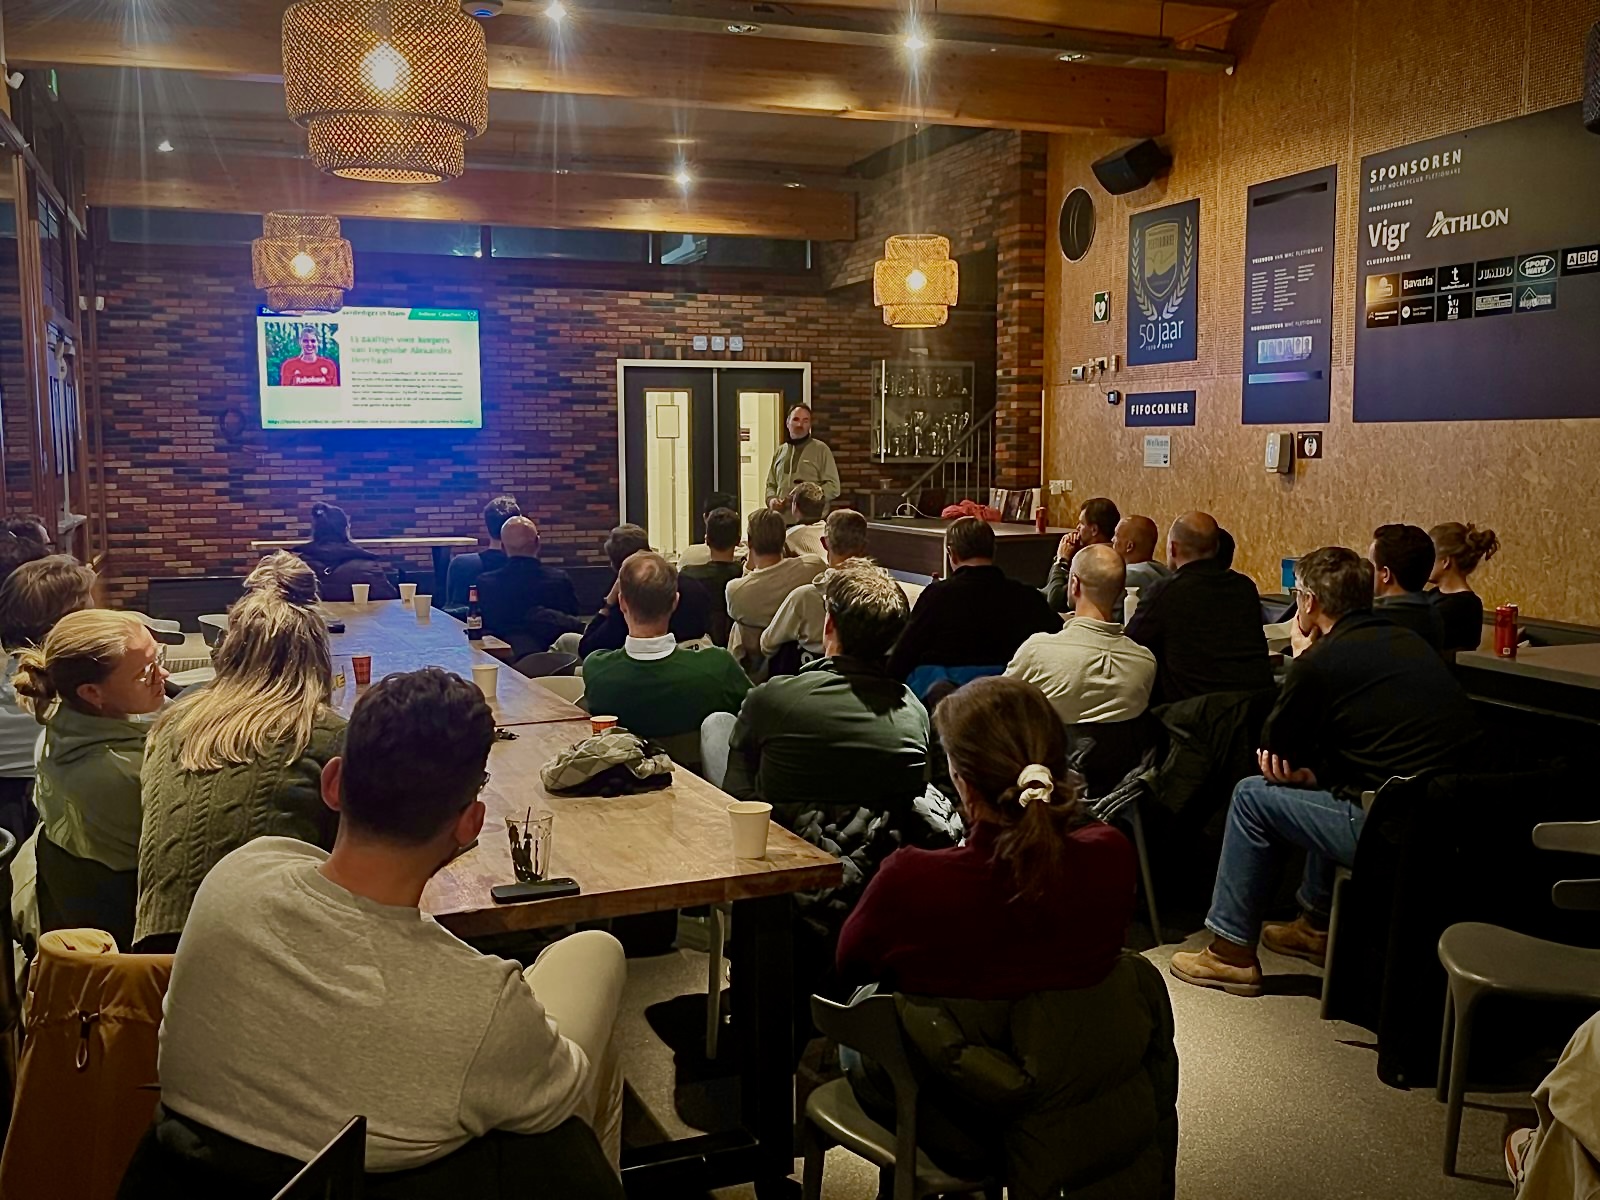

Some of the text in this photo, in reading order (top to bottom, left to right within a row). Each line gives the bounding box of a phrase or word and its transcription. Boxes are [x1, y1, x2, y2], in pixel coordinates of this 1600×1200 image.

[1370, 149, 1462, 184] SPONSOREN
[1368, 207, 1509, 252] Vigr ATHLON
[1525, 258, 1550, 268] SPORT
[1478, 266, 1513, 281] JUMBO
[1403, 275, 1434, 290] Bavaria
[1139, 316, 1184, 349] 50 jaar
[1131, 403, 1189, 415] FIFOCORNER
